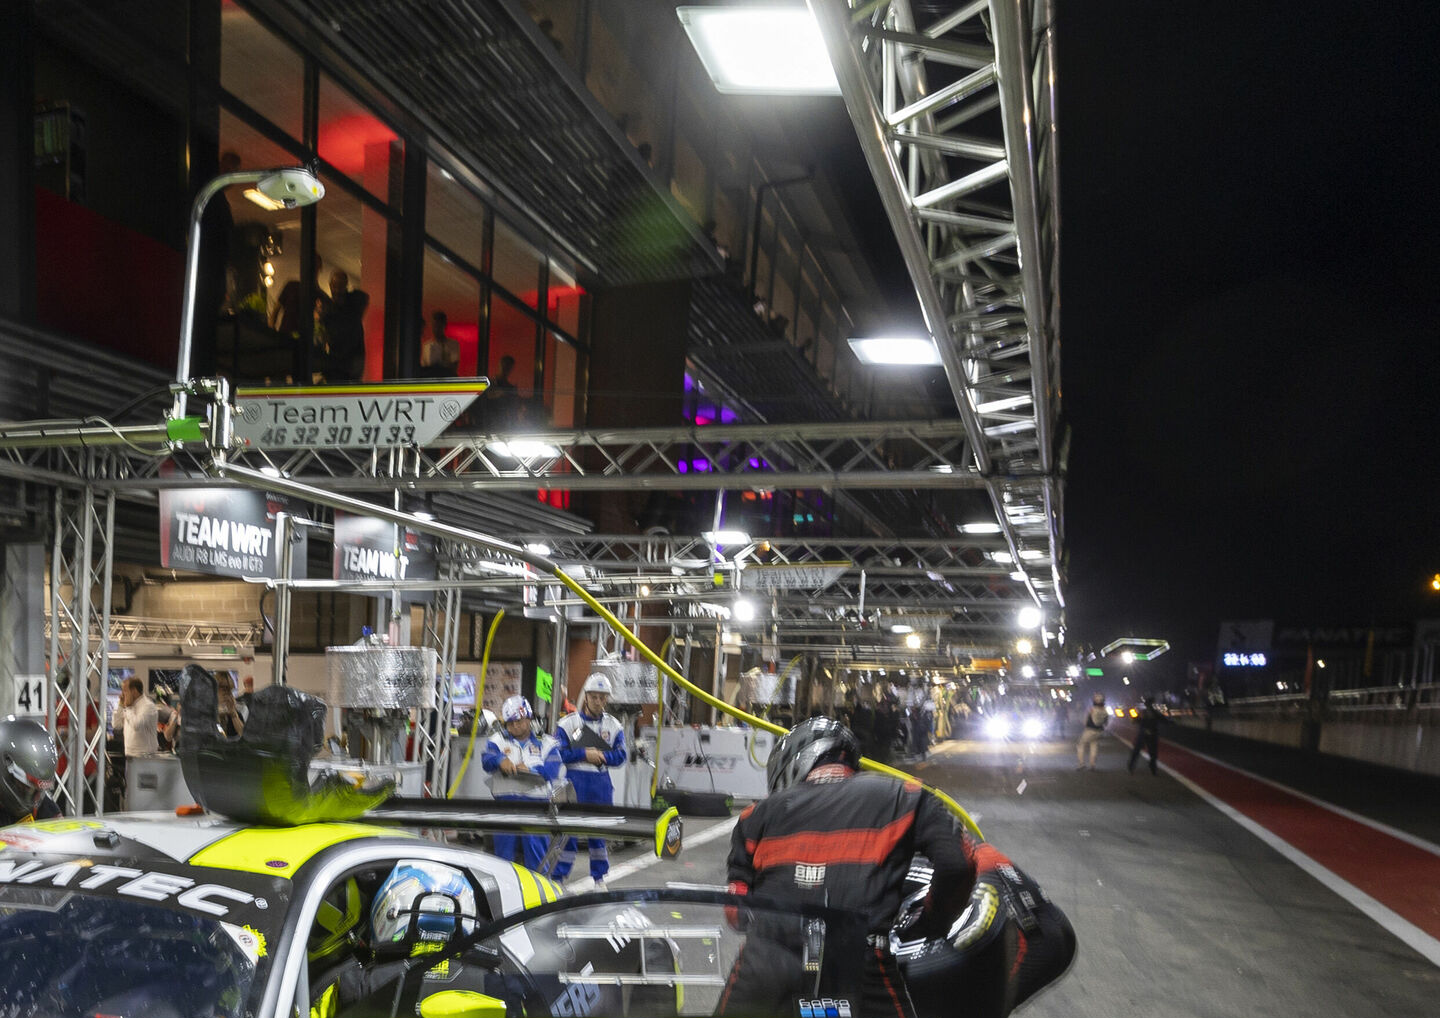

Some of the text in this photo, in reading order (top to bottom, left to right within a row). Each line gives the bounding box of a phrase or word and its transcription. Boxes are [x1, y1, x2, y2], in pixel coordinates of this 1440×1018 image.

[268, 399, 434, 424] Team WRT
[261, 426, 417, 446] 46 32 30 31 33
[175, 511, 273, 558] TEAM WRT
[343, 544, 410, 581] TEAM WT
[17, 681, 43, 712] 41
